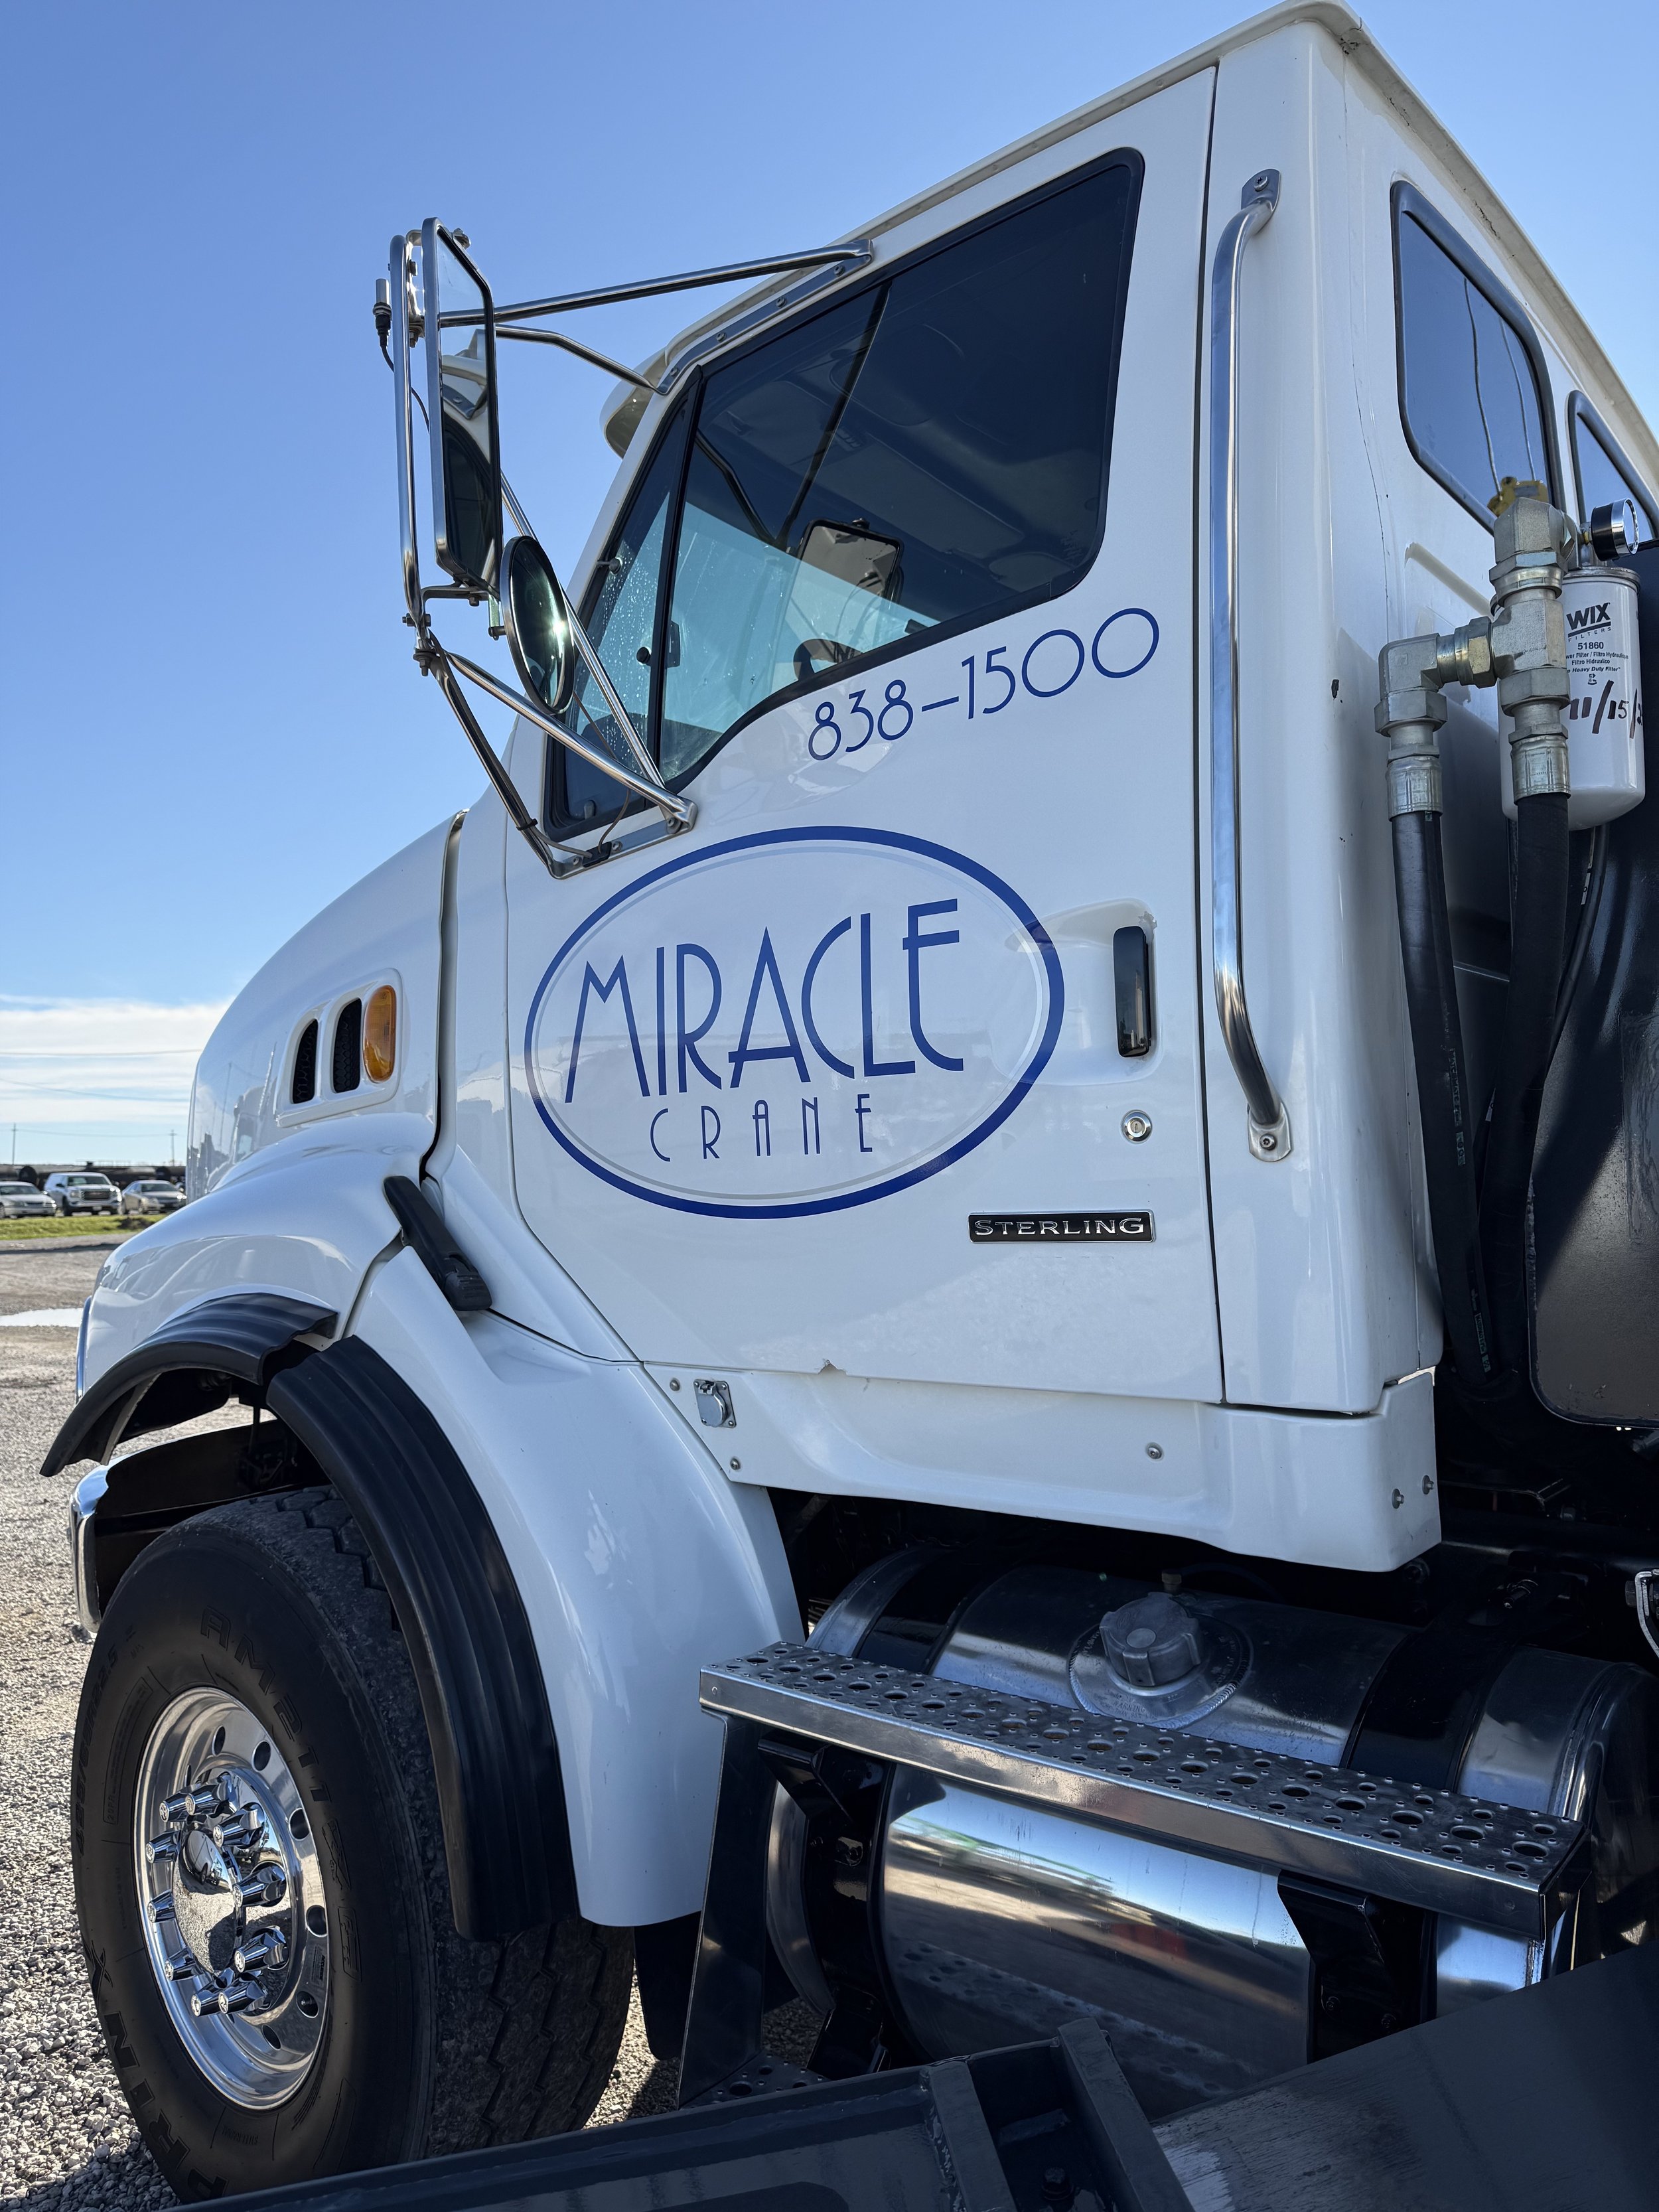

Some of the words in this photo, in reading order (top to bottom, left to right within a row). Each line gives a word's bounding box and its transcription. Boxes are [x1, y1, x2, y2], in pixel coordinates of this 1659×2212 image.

[1566, 603, 1611, 630] WIX
[1568, 627, 1611, 642] FILTERS
[808, 608, 1159, 761] 838-1500
[565, 898, 964, 1104] MIRACLE
[650, 1094, 873, 1163] CRANE
[974, 1218, 1144, 1236] STERLING
